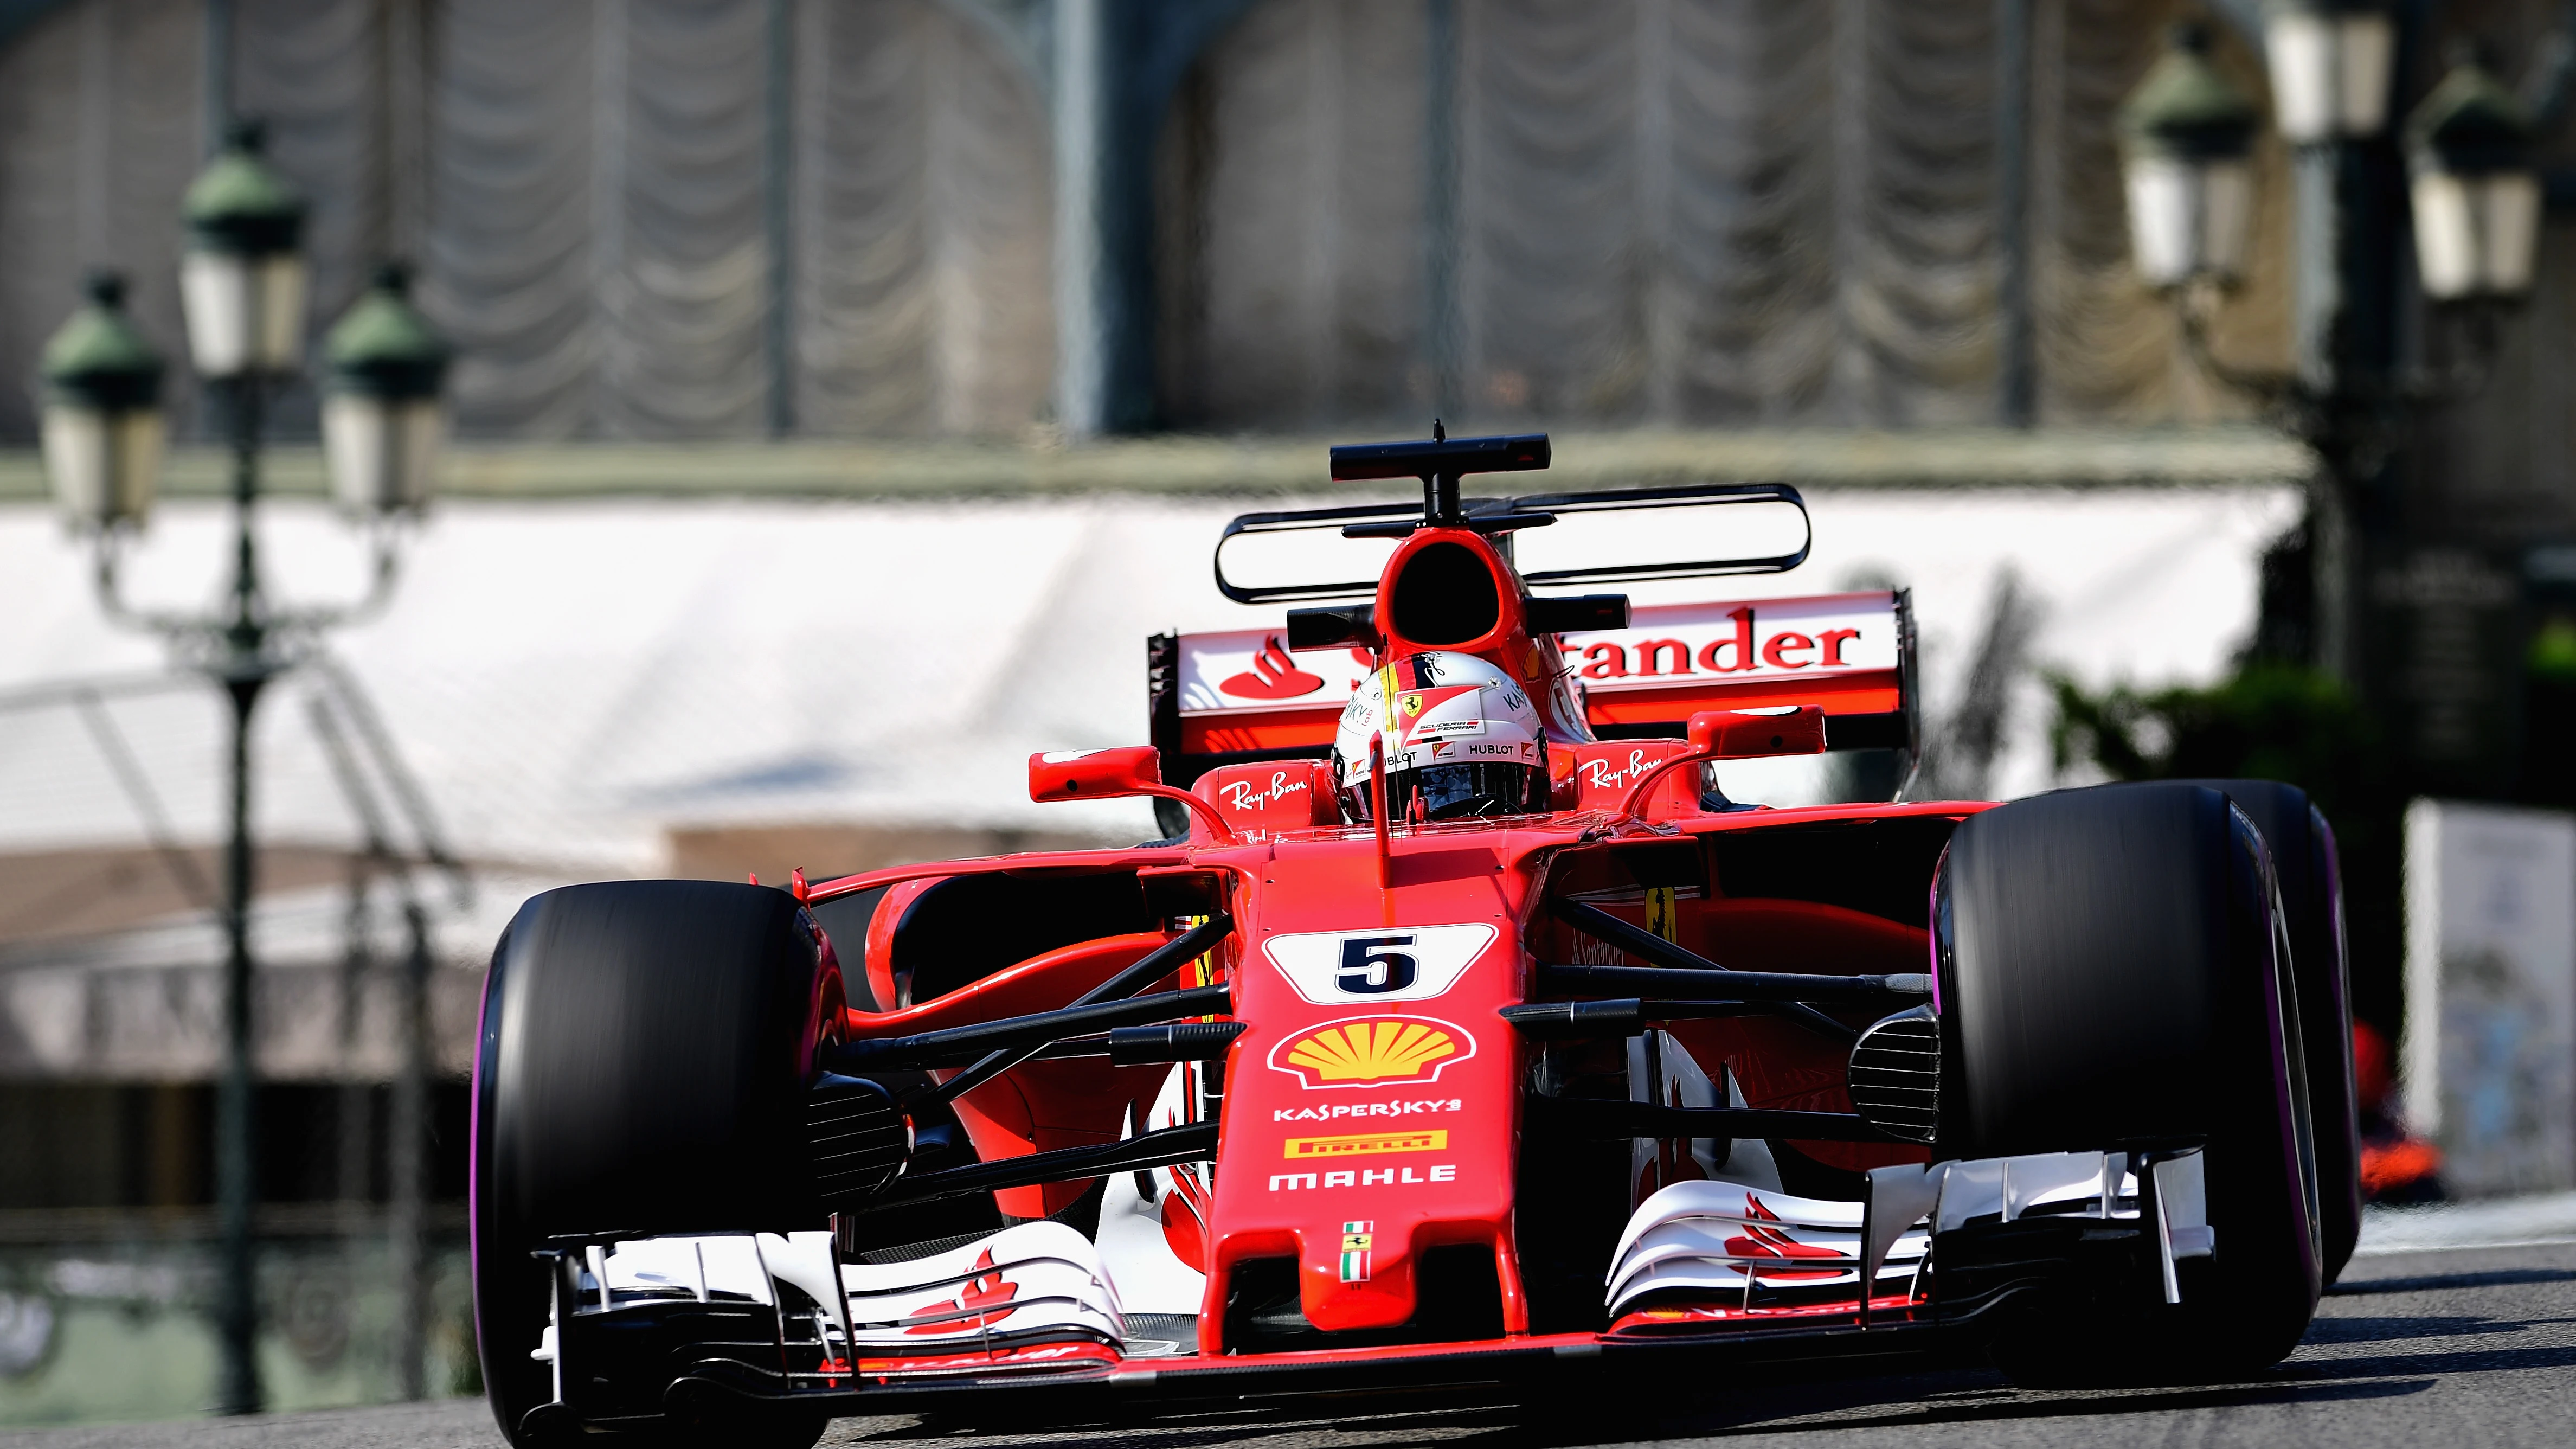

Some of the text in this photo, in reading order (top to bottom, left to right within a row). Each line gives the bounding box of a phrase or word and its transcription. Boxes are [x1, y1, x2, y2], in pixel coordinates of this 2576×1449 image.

[1419, 722, 1466, 730] SCUDERIA
[1385, 752, 1417, 767] BLOT
[1469, 745, 1514, 755] HUBLOT
[1578, 749, 1663, 788] Ray-Ban
[1220, 772, 1308, 811] Ray-Ban
[1334, 935, 1418, 995] 5
[1274, 1100, 1446, 1121] KASPERSKY
[1299, 1134, 1433, 1154] PIRELLI
[1269, 1165, 1456, 1191] MAHLE
